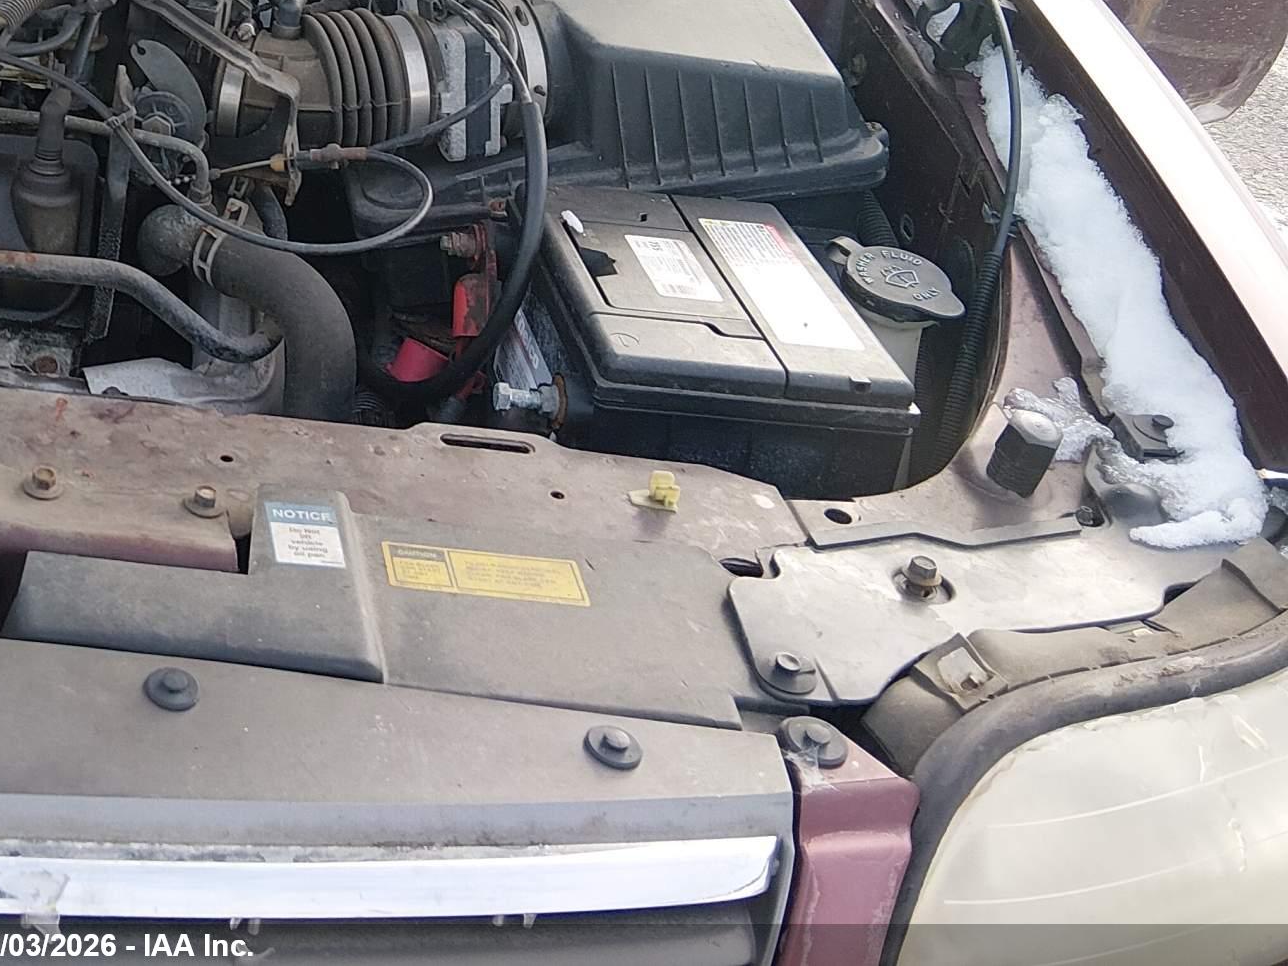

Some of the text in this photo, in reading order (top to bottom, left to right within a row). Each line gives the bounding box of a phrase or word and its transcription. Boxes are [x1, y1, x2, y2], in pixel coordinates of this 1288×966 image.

[855, 250, 922, 285] WASHER FLUID
[912, 286, 942, 301] ONLY
[271, 508, 331, 522] NOTICE
